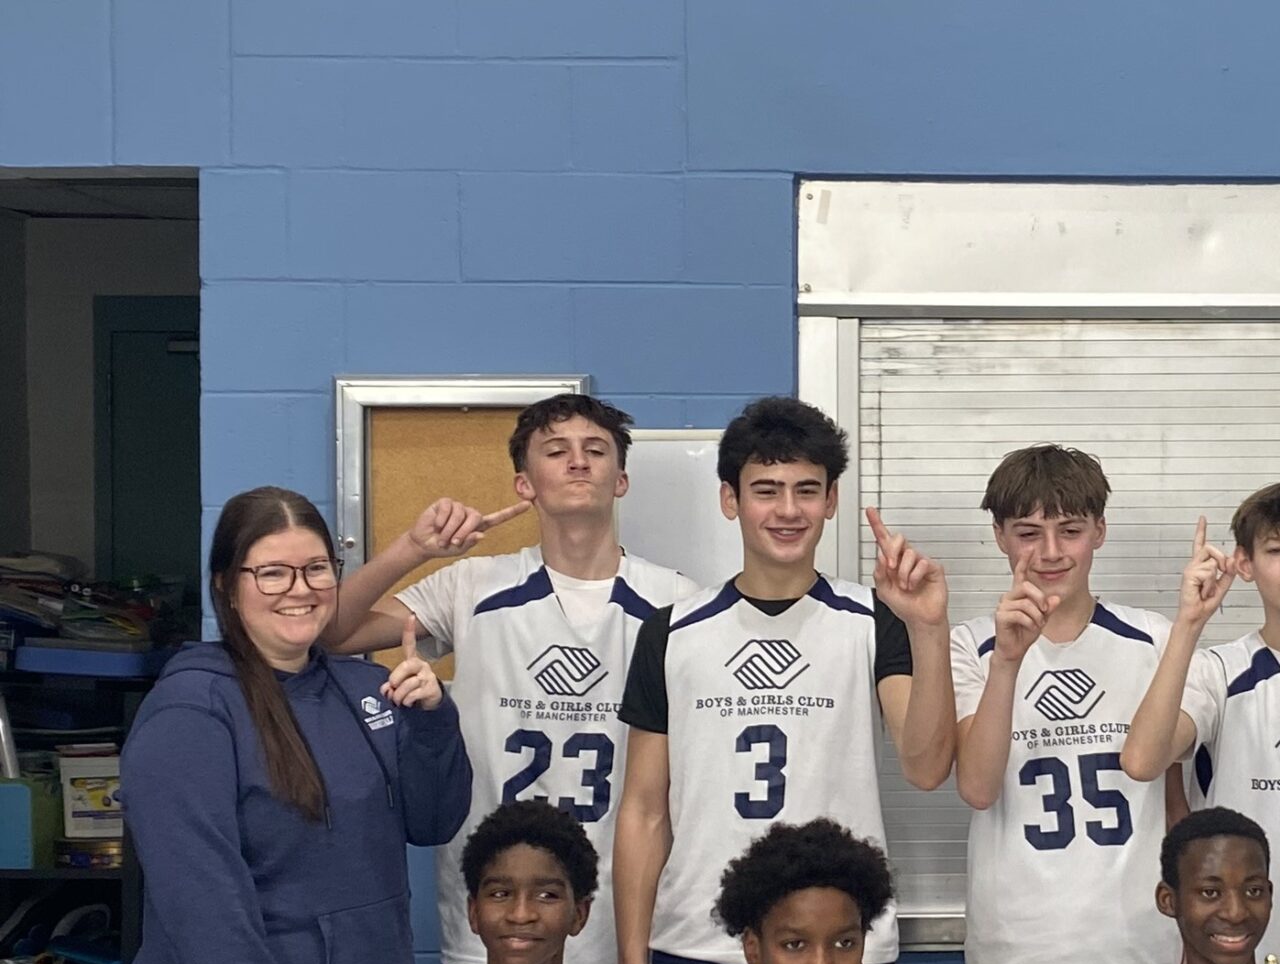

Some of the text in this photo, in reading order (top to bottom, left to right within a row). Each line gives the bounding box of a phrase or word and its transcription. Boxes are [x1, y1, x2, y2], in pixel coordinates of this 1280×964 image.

[499, 698, 623, 713] BOYS & GIRLS CLU
[696, 695, 835, 709] BOYS & GIRLS CLUB
[520, 710, 607, 722] OF MANCHESTER
[720, 706, 809, 717] OF MANCHESTER
[1011, 729, 1037, 741] OYS
[1041, 728, 1051, 737] &
[1055, 724, 1096, 737] GIRLS
[1027, 734, 1113, 750] OF MANCHESTER
[502, 729, 615, 823] 23
[734, 724, 787, 819] 3
[1018, 752, 1133, 851] 35
